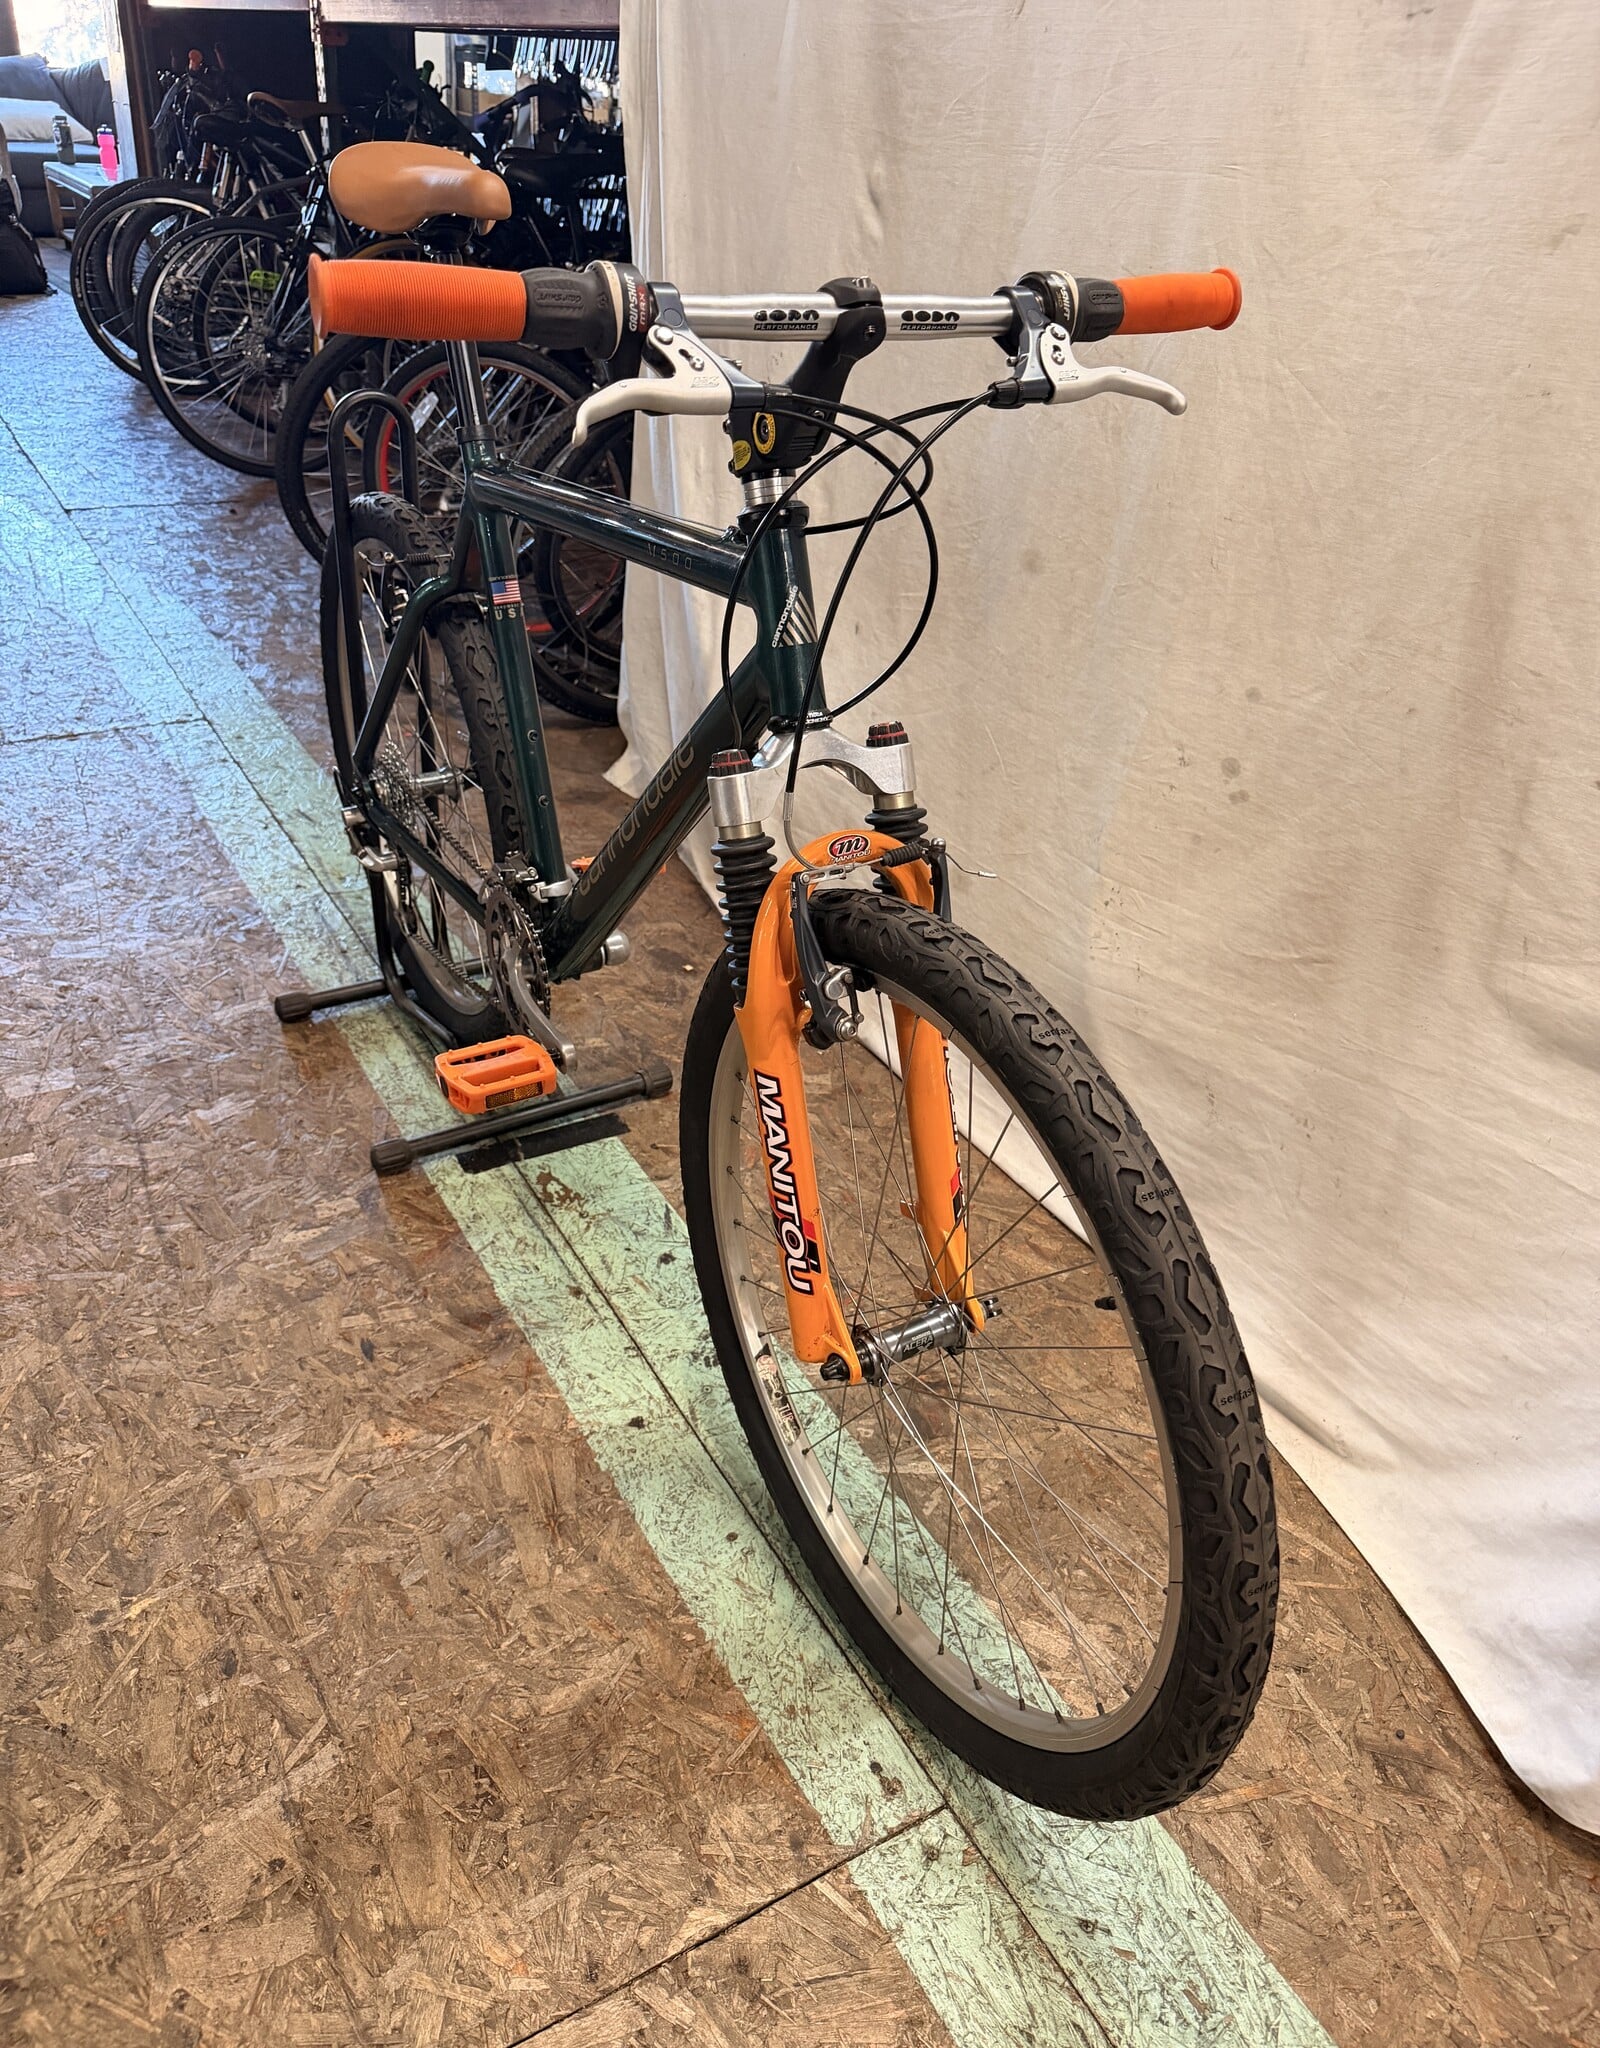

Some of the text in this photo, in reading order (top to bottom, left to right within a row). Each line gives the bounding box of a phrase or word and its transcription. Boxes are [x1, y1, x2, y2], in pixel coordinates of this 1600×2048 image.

[754, 323, 818, 331] PERFORMANCE
[900, 323, 958, 331] PERFORMANCE
[771, 584, 799, 649] cannondale
[755, 1071, 813, 1294] MANITOU
